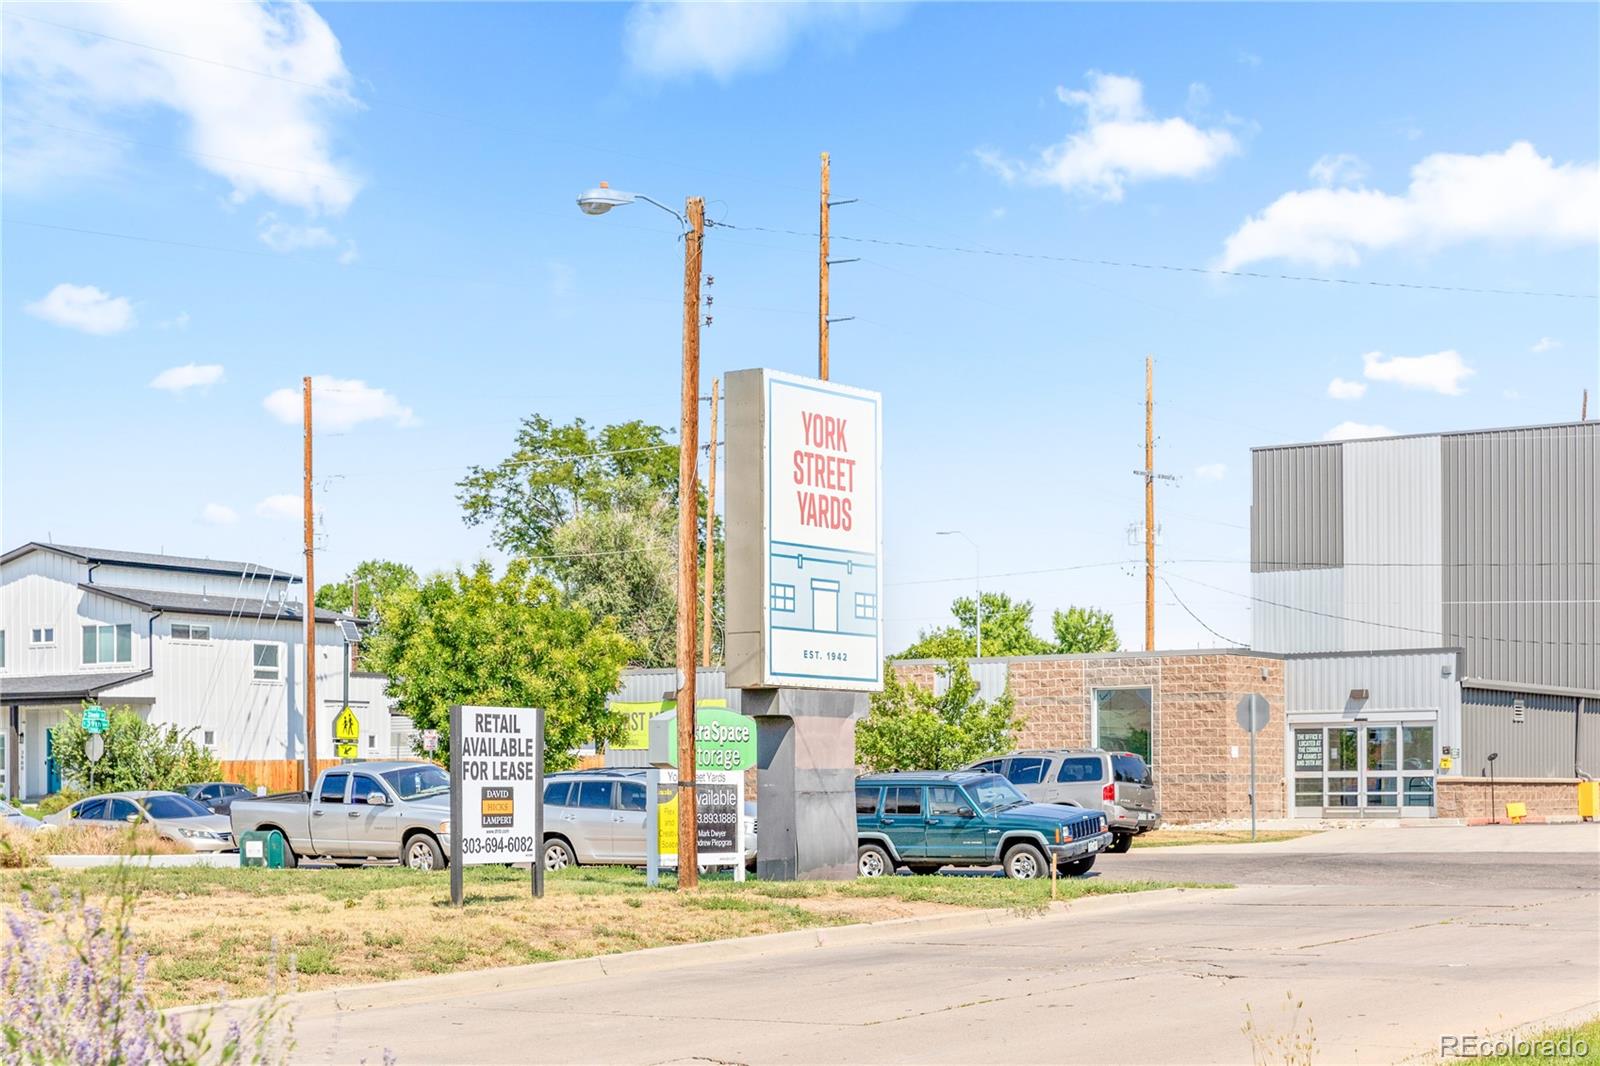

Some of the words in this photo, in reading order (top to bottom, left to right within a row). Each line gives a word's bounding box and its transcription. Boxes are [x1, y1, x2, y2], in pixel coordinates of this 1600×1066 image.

[801, 411, 848, 452] YORK
[793, 450, 856, 493] STREET
[797, 490, 853, 532] YARDS
[803, 649, 823, 661] EST.
[826, 651, 849, 663] 1942
[475, 713, 521, 733] RETAIL
[462, 736, 534, 757] AVAILABLE
[696, 746, 741, 770] torage
[463, 761, 489, 780] FOR
[492, 761, 534, 781] LEASE
[668, 771, 678, 782] Yo
[706, 771, 727, 782] Yards
[486, 790, 509, 798] DAVID
[696, 789, 737, 806] vailable
[487, 803, 508, 811] HICKS
[482, 816, 513, 825] LAMPERT
[696, 813, 737, 824] 3.893.1886
[698, 829, 710, 837] Mark
[462, 836, 534, 854] 303-694-6082
[696, 839, 711, 847] ndrew
